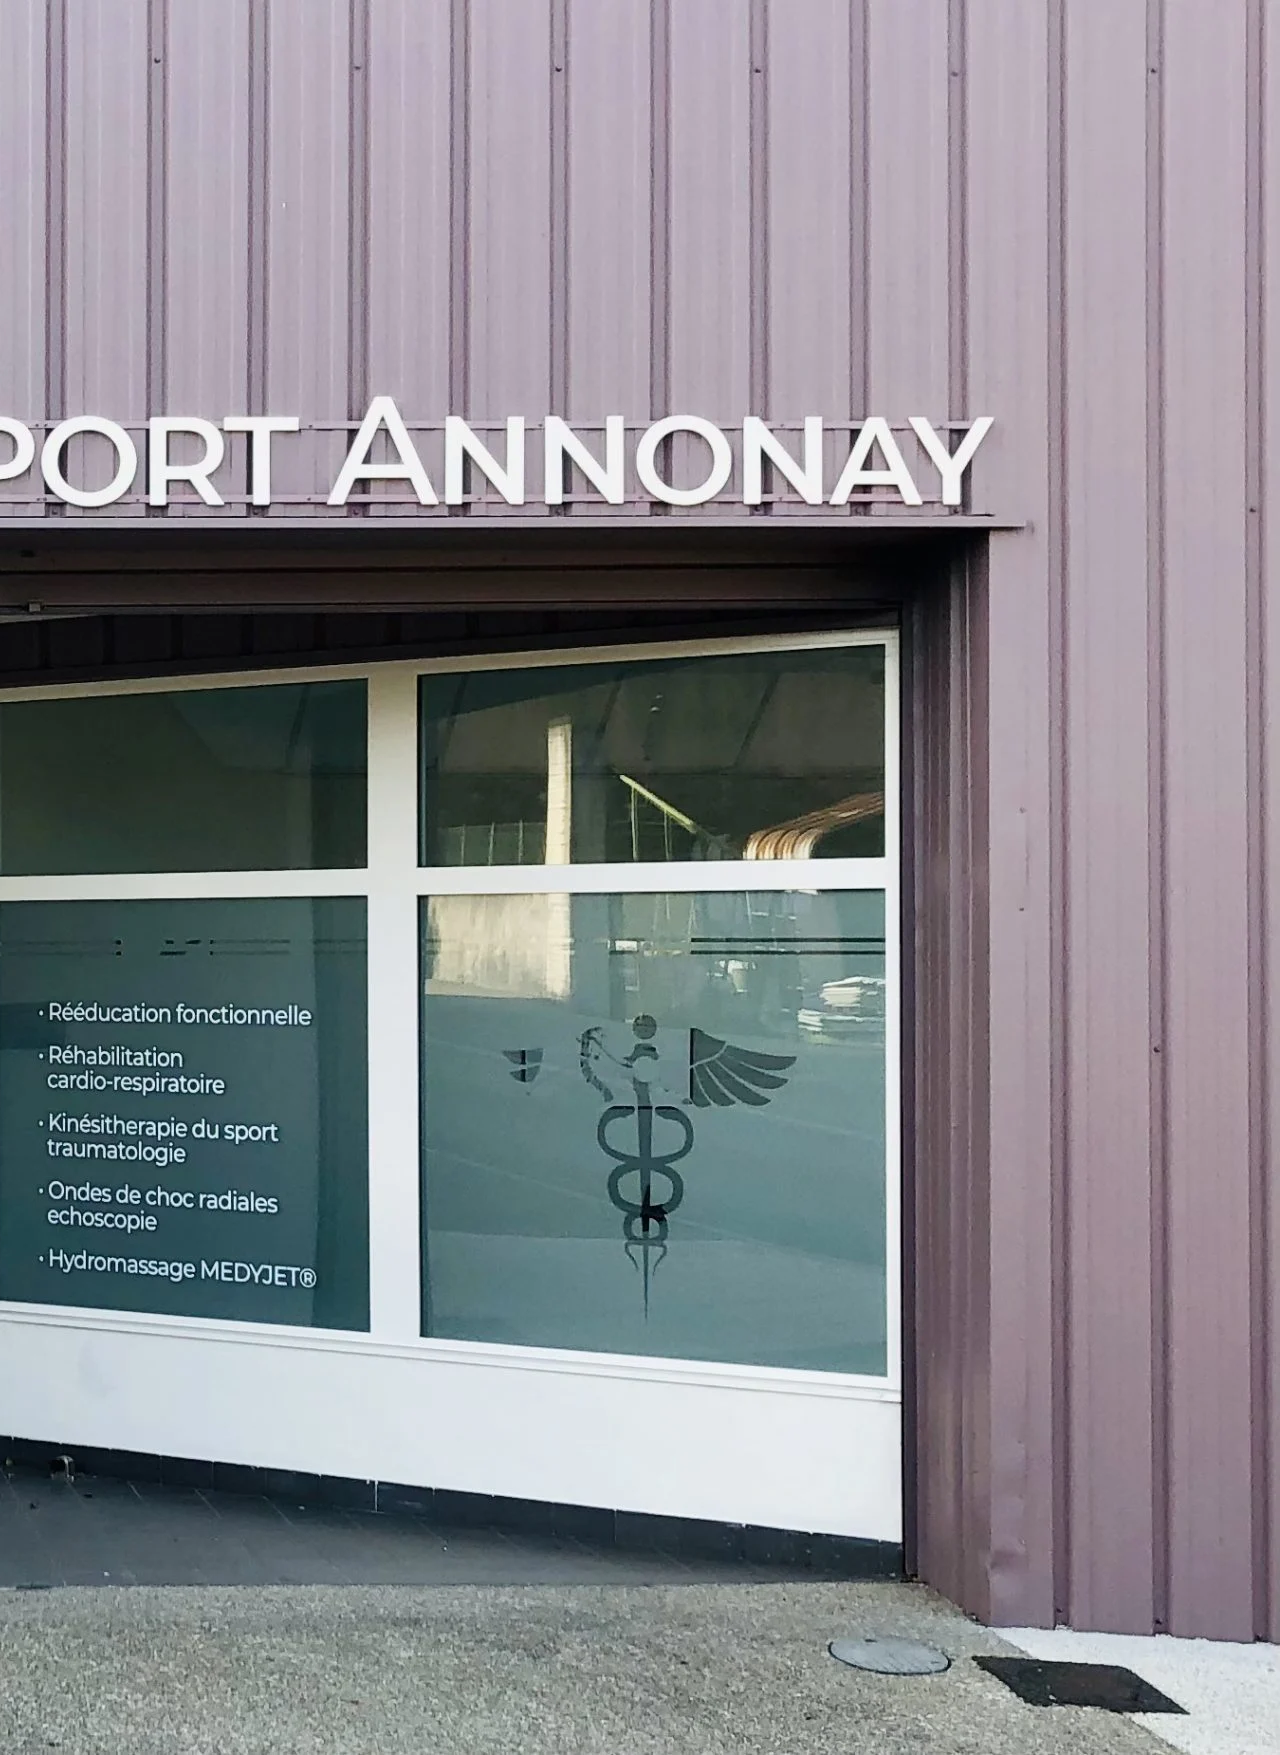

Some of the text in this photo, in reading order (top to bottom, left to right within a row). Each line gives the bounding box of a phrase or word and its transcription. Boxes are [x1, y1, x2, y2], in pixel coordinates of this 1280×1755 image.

[327, 395, 995, 506] ANNONAY
[49, 1001, 312, 1026] Rééducation fonctionnelle
[49, 1044, 183, 1068] Réhabilitation
[47, 1069, 225, 1096] cardio-respiratoire
[49, 1112, 279, 1145] Kinésitherapie du sport
[46, 1138, 186, 1167] traumatologie
[48, 1180, 278, 1214] Ondes de choc radiales
[47, 1205, 158, 1234] echoscopie
[49, 1248, 196, 1281] Hydromassage
